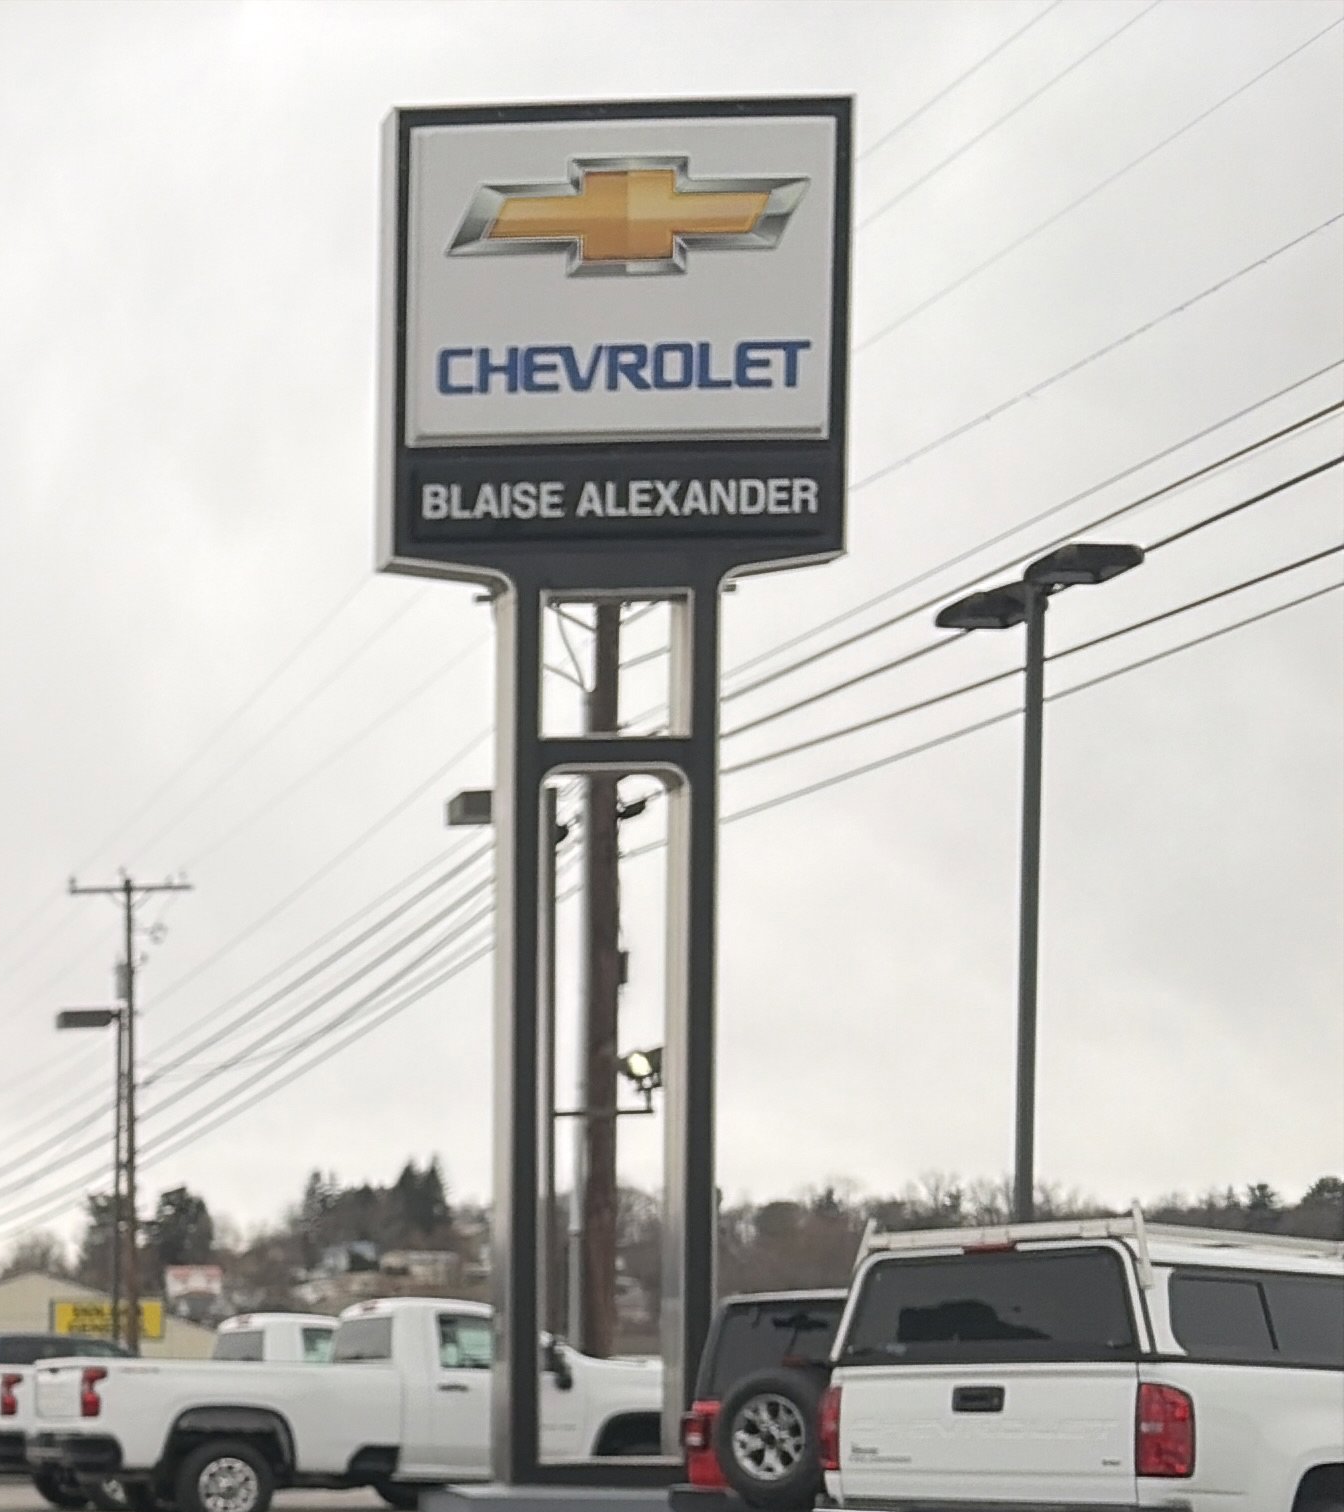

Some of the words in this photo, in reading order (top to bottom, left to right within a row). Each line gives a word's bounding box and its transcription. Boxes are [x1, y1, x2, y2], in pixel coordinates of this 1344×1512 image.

[437, 340, 811, 394] CHEVROLET
[422, 482, 565, 519] BLAISE
[576, 478, 819, 516] ALEXANDER
